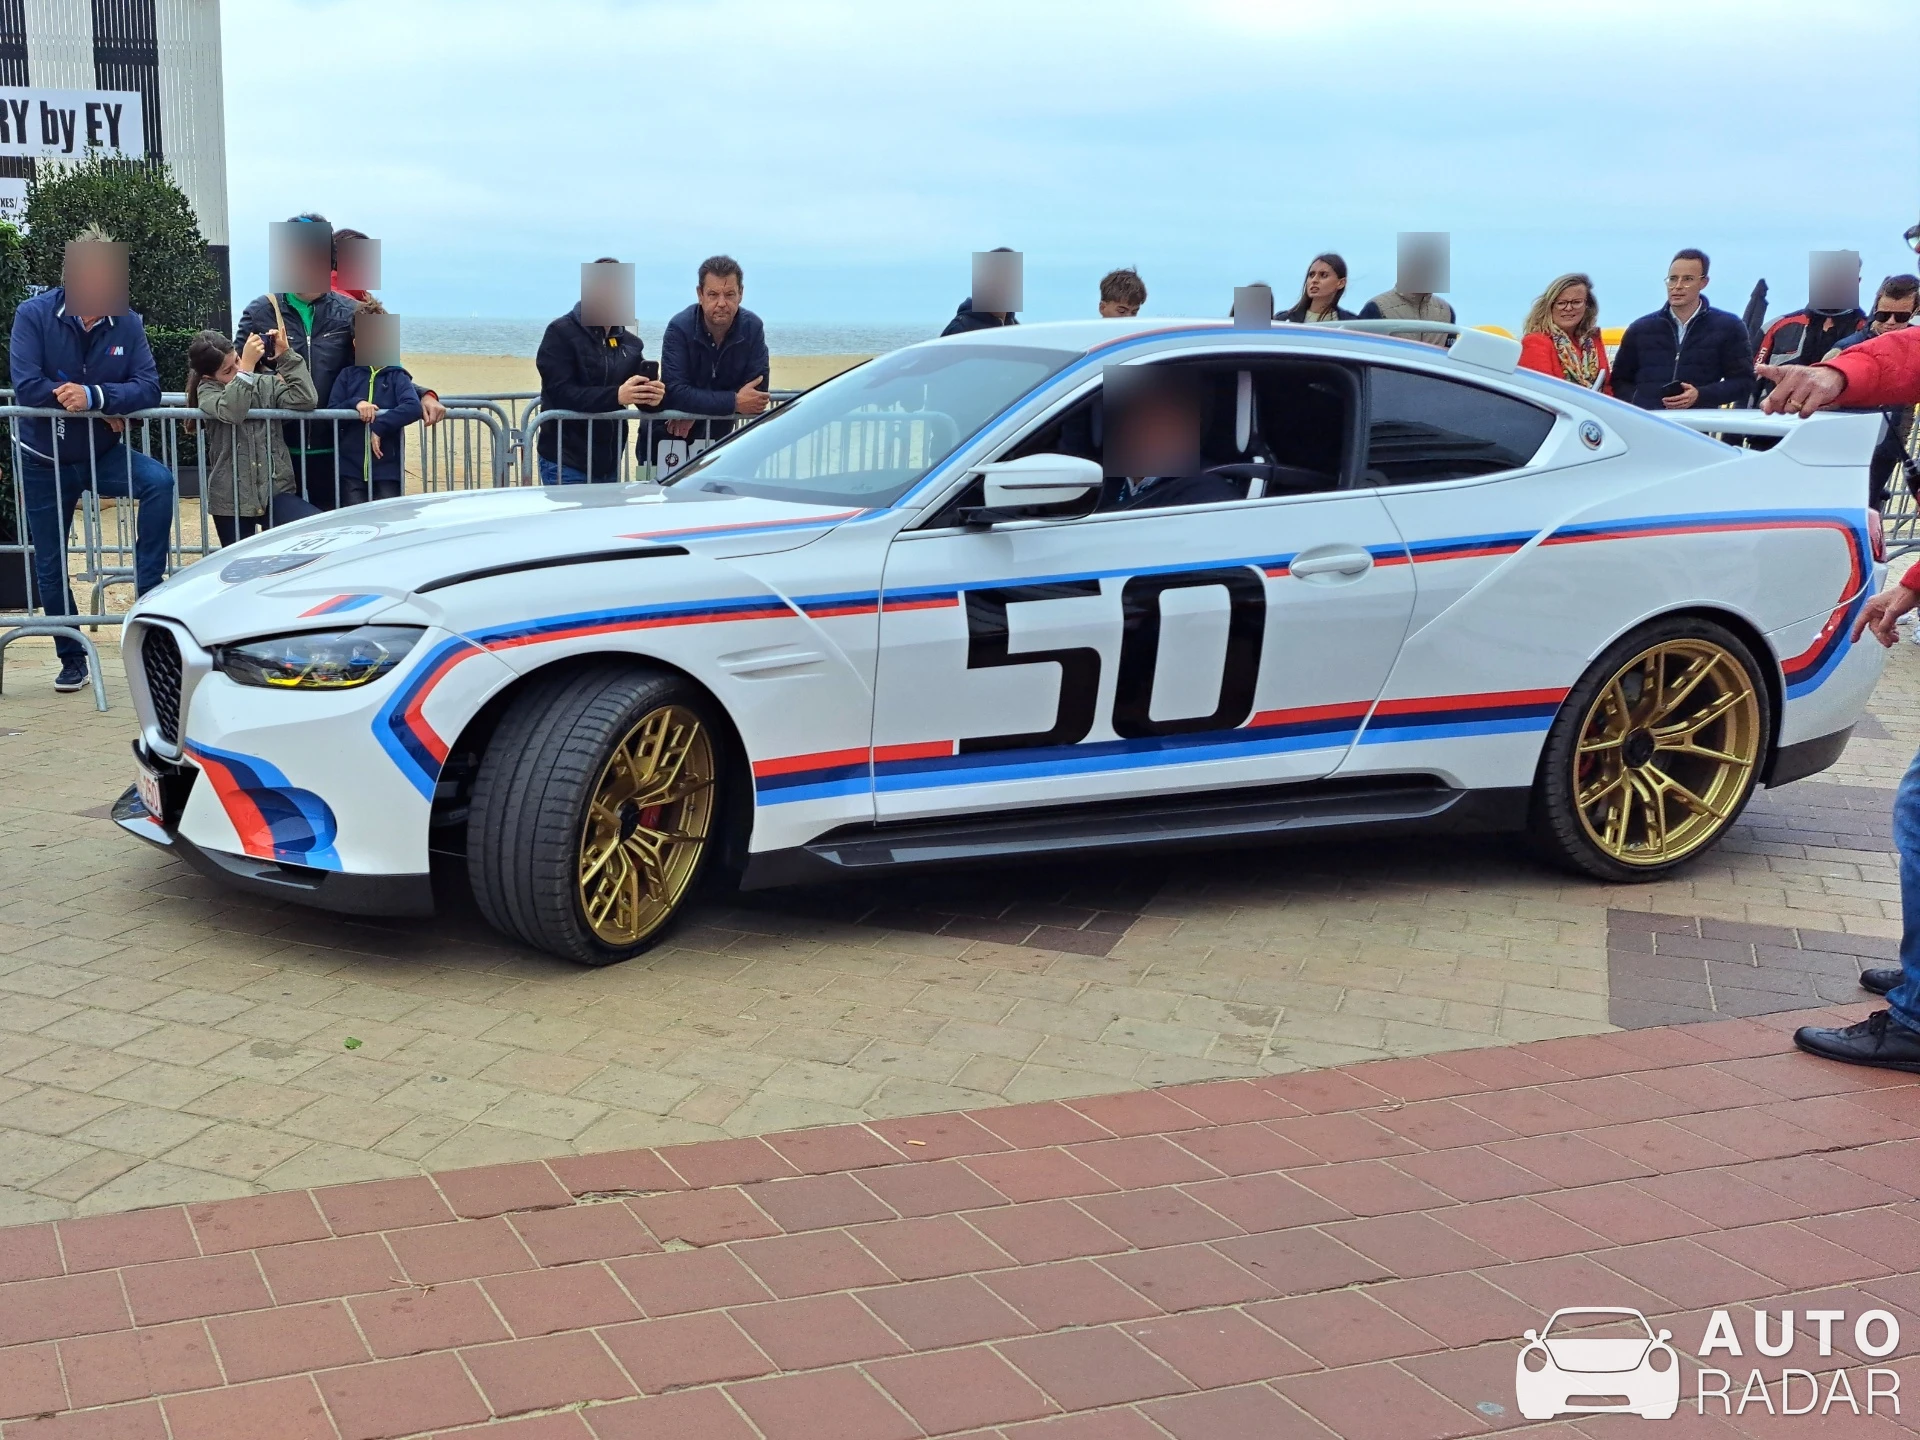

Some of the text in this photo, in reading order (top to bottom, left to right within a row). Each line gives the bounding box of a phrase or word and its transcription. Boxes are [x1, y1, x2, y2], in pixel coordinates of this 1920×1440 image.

[40, 101, 76, 153] by
[86, 102, 122, 147] EY
[57, 416, 65, 439] wer
[959, 565, 1266, 755] 50
